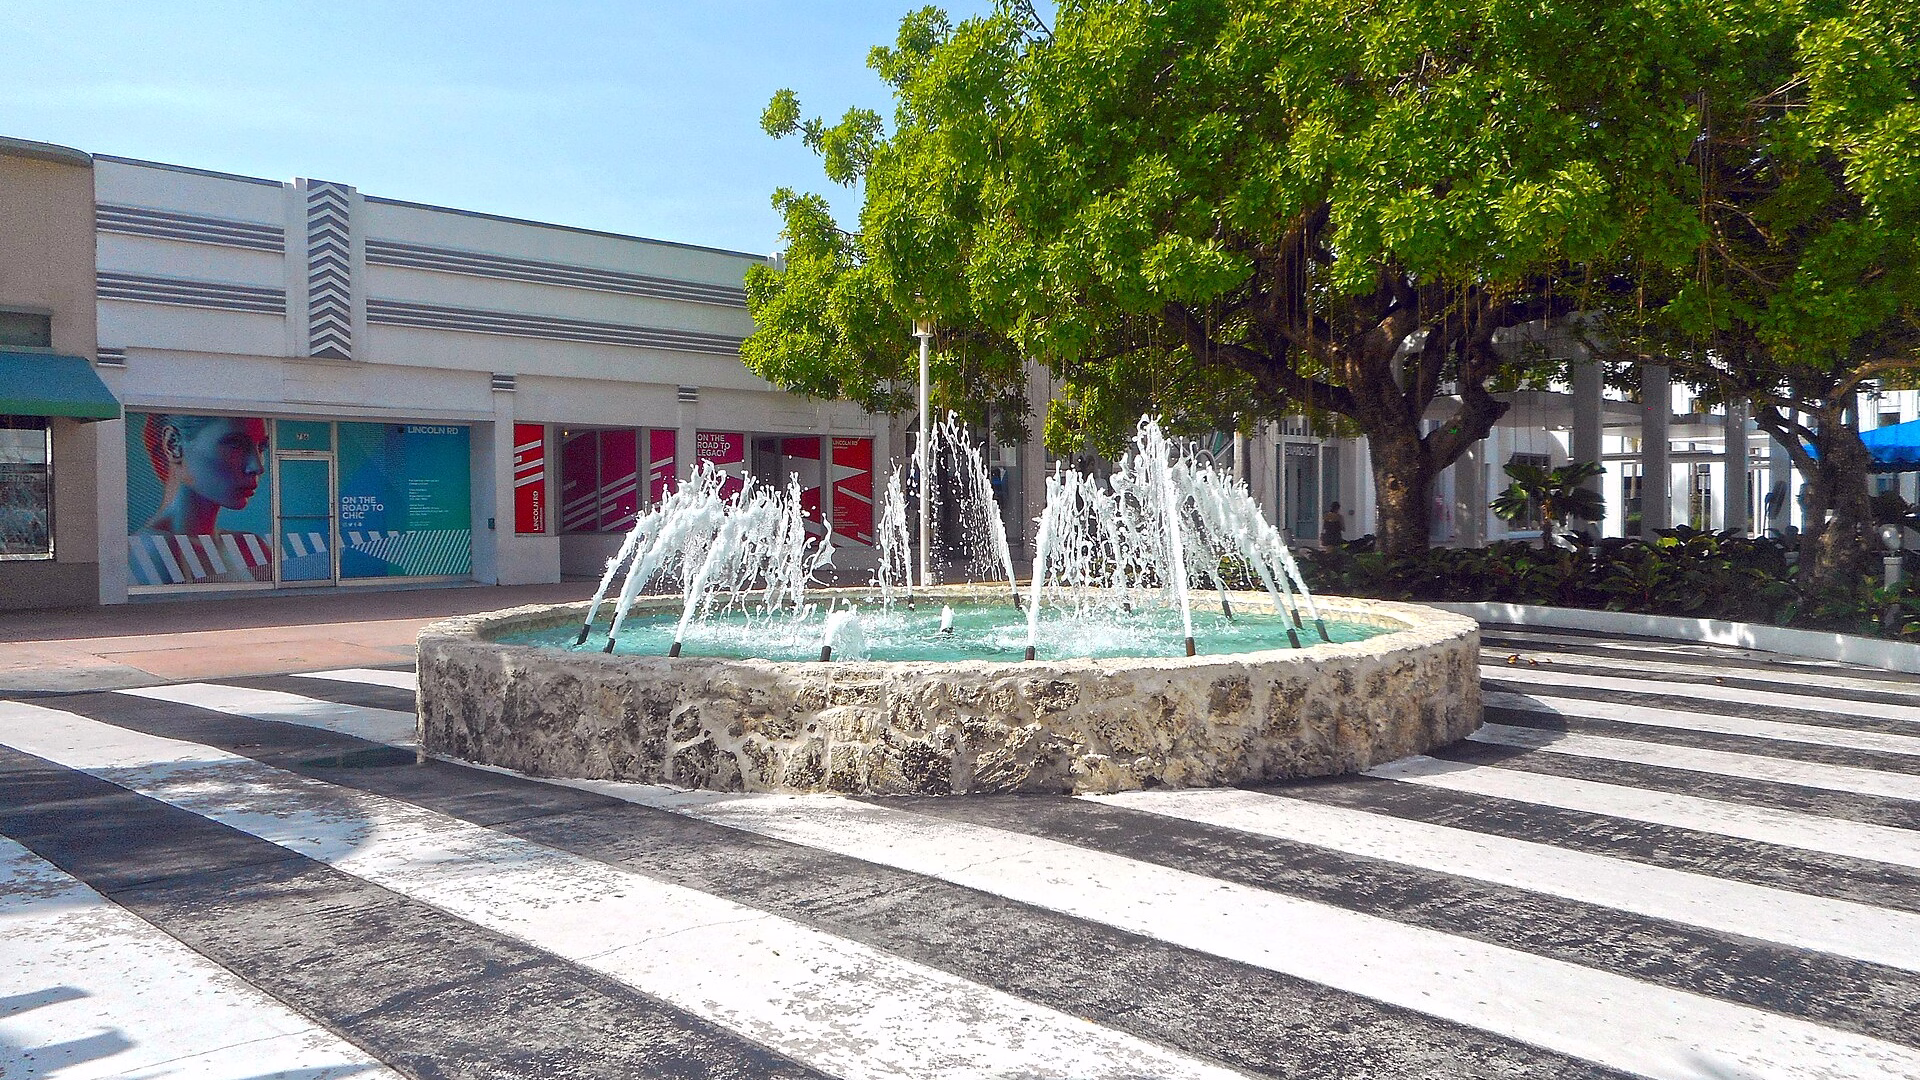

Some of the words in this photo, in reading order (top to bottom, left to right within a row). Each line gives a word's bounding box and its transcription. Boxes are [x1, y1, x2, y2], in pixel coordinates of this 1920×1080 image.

[407, 426, 445, 434] LINCOLN
[710, 434, 725, 442] THE
[697, 449, 726, 457] LEGACY
[533, 491, 539, 501] RD
[342, 504, 369, 512] ROAD
[371, 504, 384, 512] TO
